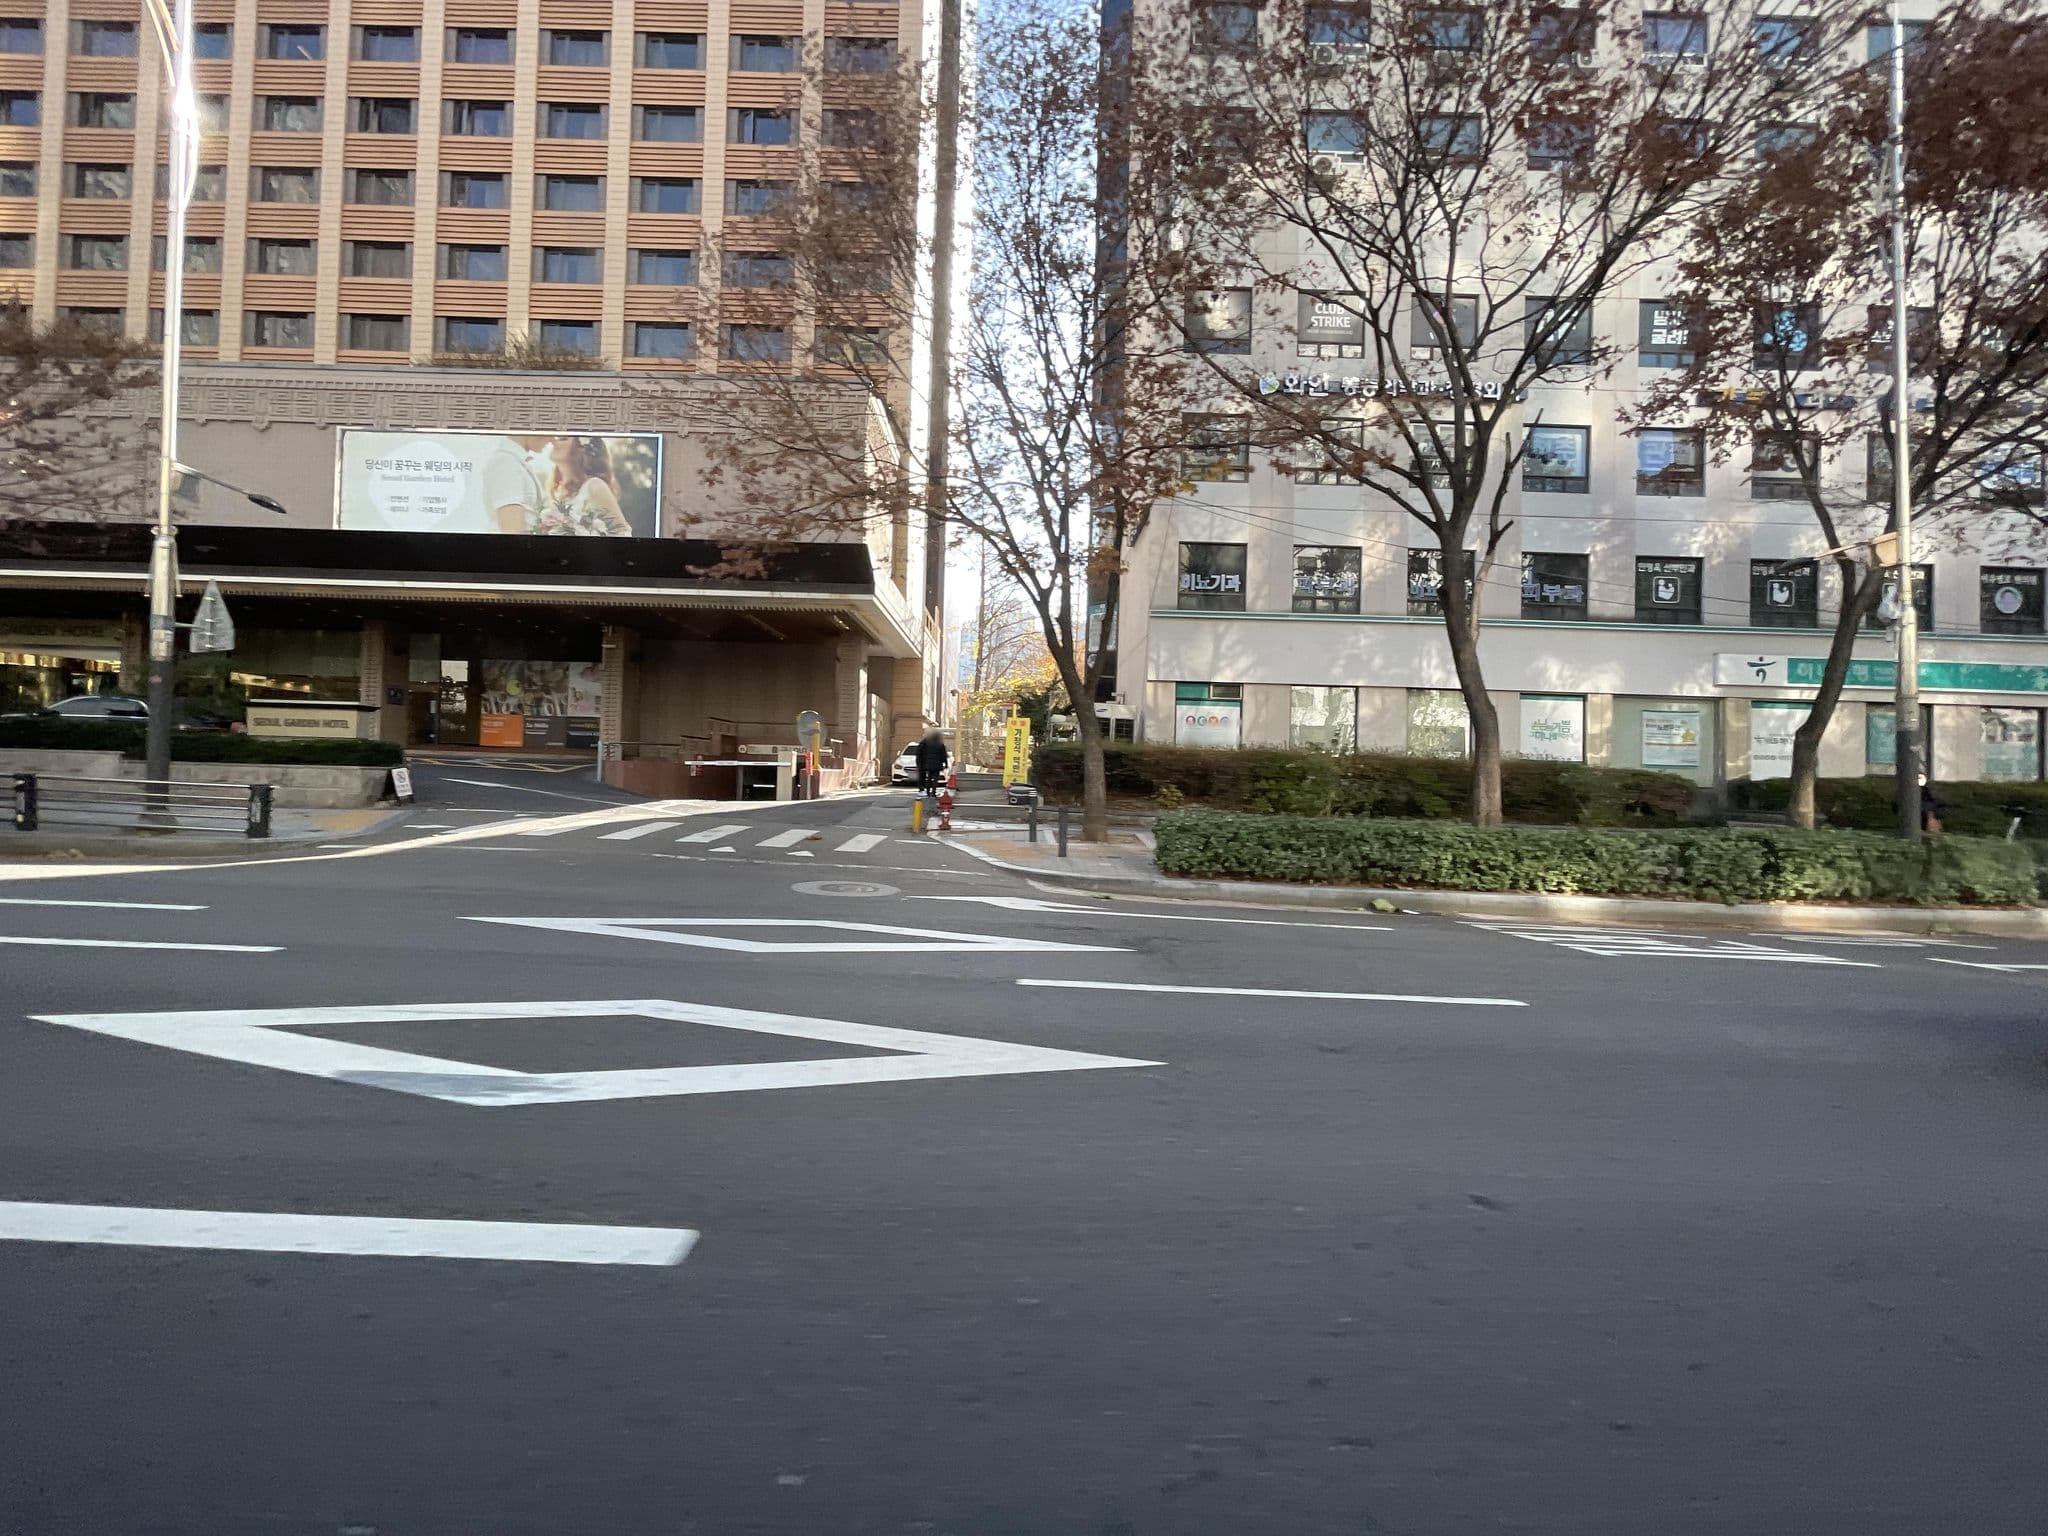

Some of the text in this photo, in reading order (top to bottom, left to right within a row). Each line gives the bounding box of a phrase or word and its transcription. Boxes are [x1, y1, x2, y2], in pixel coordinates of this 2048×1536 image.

[1315, 303, 1345, 315] CLUB
[1311, 315, 1351, 328] STRIKE
[395, 459, 422, 471] 꿈꾸는
[424, 460, 452, 472] 웨딩의
[453, 461, 472, 472] 시작
[253, 717, 350, 729] SEOUL GARDEN HOTEL
